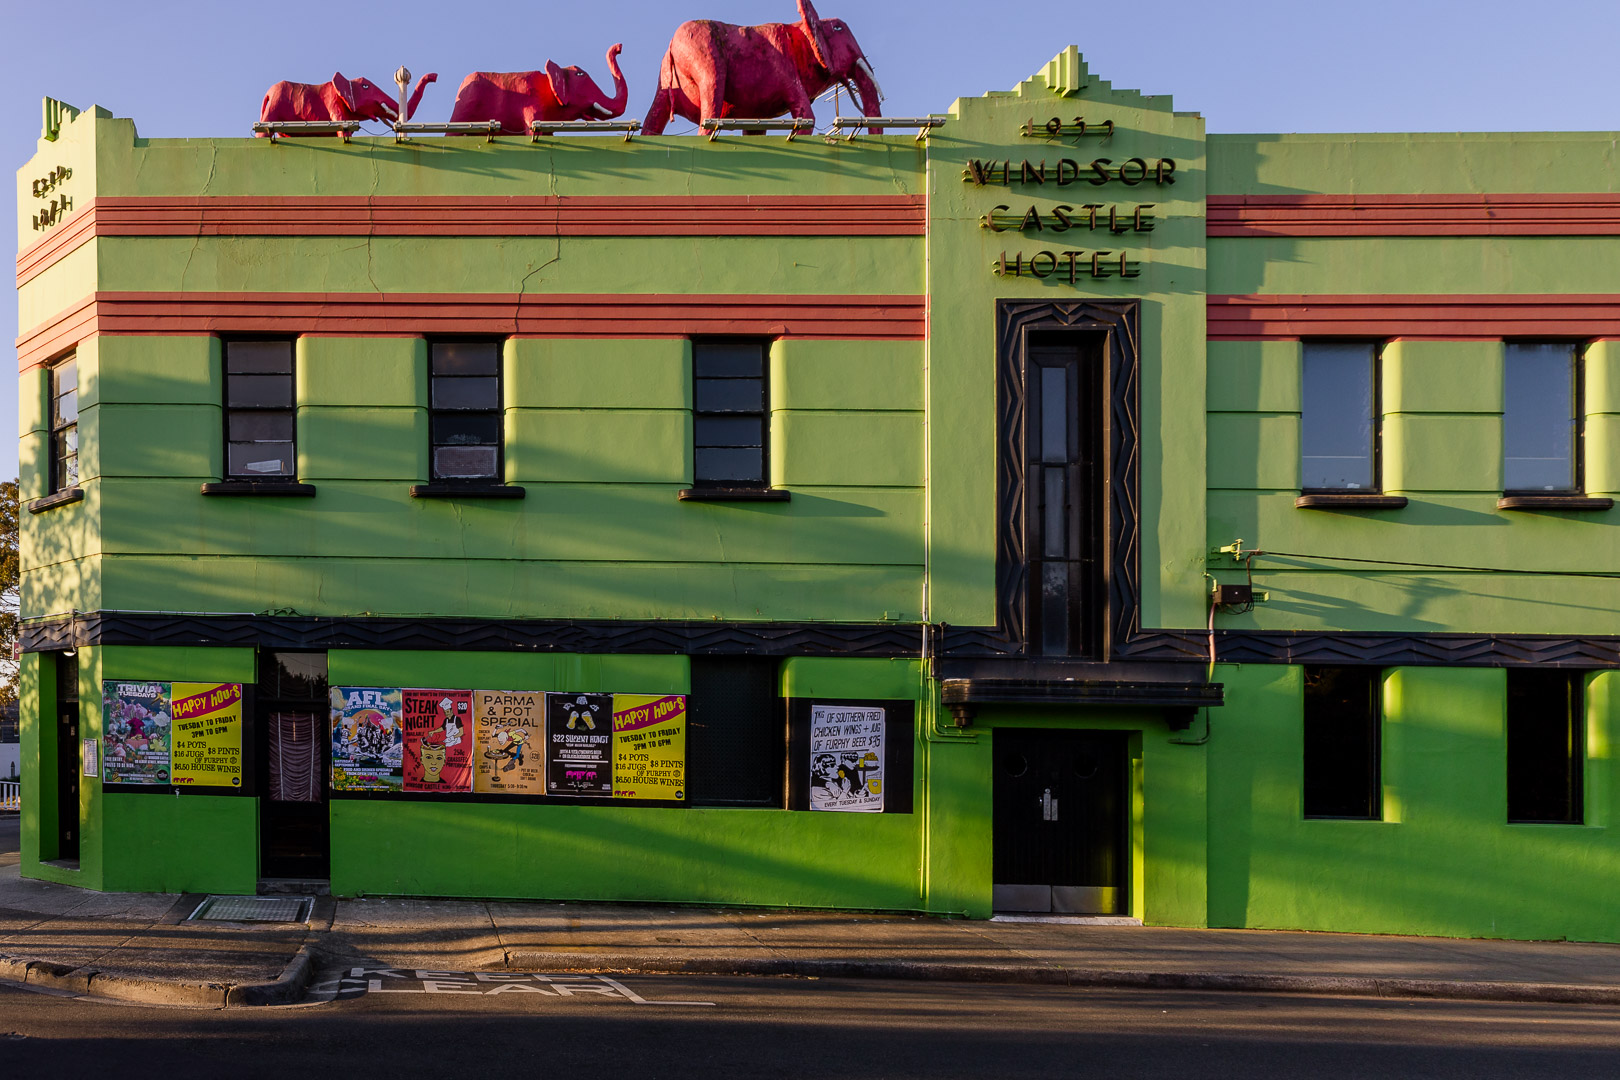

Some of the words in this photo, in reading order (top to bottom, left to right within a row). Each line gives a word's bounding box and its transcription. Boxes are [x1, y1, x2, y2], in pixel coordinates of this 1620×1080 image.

[967, 157, 1176, 187] WINDSOR
[987, 203, 1156, 234] CASTLE
[999, 250, 1140, 284] HOTEL
[117, 684, 157, 693] TRIVIA
[346, 690, 388, 706] AFL
[484, 696, 535, 706] PARMA
[172, 697, 206, 718] HAPPY
[405, 698, 438, 714] STEAK
[488, 706, 496, 716] &
[504, 707, 532, 716] POT
[178, 721, 204, 732] TUESDAY
[206, 718, 214, 726] TO
[214, 715, 237, 725] FRIDAY
[405, 715, 436, 730] NIGHT
[481, 717, 538, 727] SPECIAL
[614, 708, 649, 730] HAPPY
[826, 713, 835, 724] OF
[836, 712, 866, 723] SOUTHERN
[866, 712, 881, 721] FRIED
[214, 726, 228, 734] 6PM
[619, 733, 647, 743] TUESDAY
[658, 728, 681, 737] FRIDAY
[814, 726, 841, 738] CHICKEN
[843, 724, 862, 735] WINGS
[870, 723, 881, 733] JUG
[553, 734, 564, 742] $22
[658, 739, 672, 747] 6PM
[814, 740, 823, 751] OF
[825, 738, 850, 750] FURPHY
[852, 736, 866, 748] BEER
[174, 763, 190, 771] $6.50
[190, 763, 216, 772] HOUSE
[216, 764, 240, 774] WINES
[650, 760, 659, 768] $8
[660, 760, 684, 768] PINTS
[615, 776, 632, 784] $6.50
[633, 776, 658, 785] HOUSE
[660, 778, 684, 786] WINES
[350, 967, 590, 982] KEEP
[308, 979, 626, 997] CLEAR
